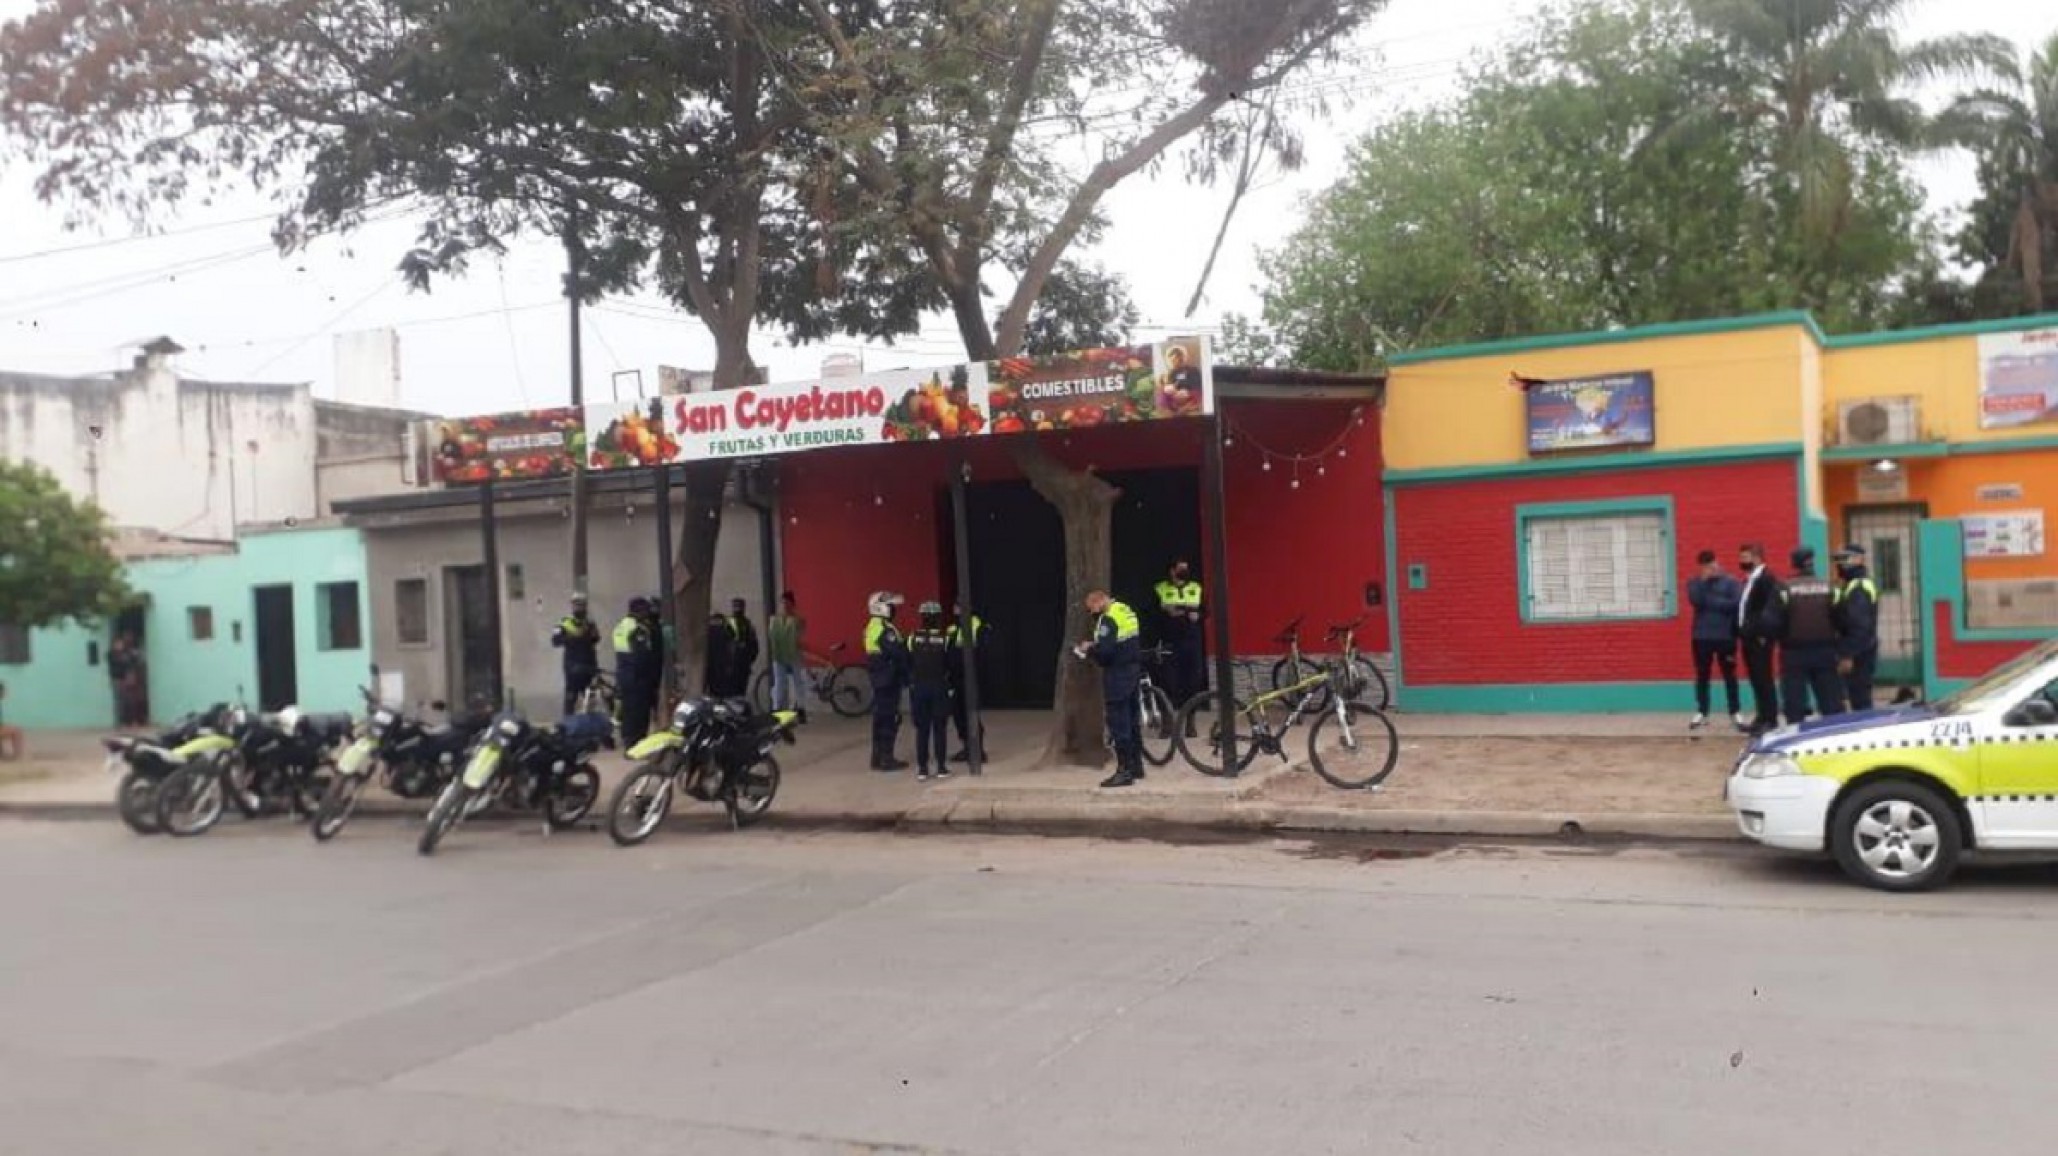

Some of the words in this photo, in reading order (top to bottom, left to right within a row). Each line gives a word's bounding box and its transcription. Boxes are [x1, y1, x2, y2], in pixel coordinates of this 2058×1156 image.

[1023, 374, 1125, 399] COMESTIBLES
[675, 398, 728, 434] San
[734, 385, 885, 432] Cayetano
[709, 435, 764, 454] FRUTAS
[768, 433, 779, 448] Y
[783, 427, 865, 446] VERDURAS
